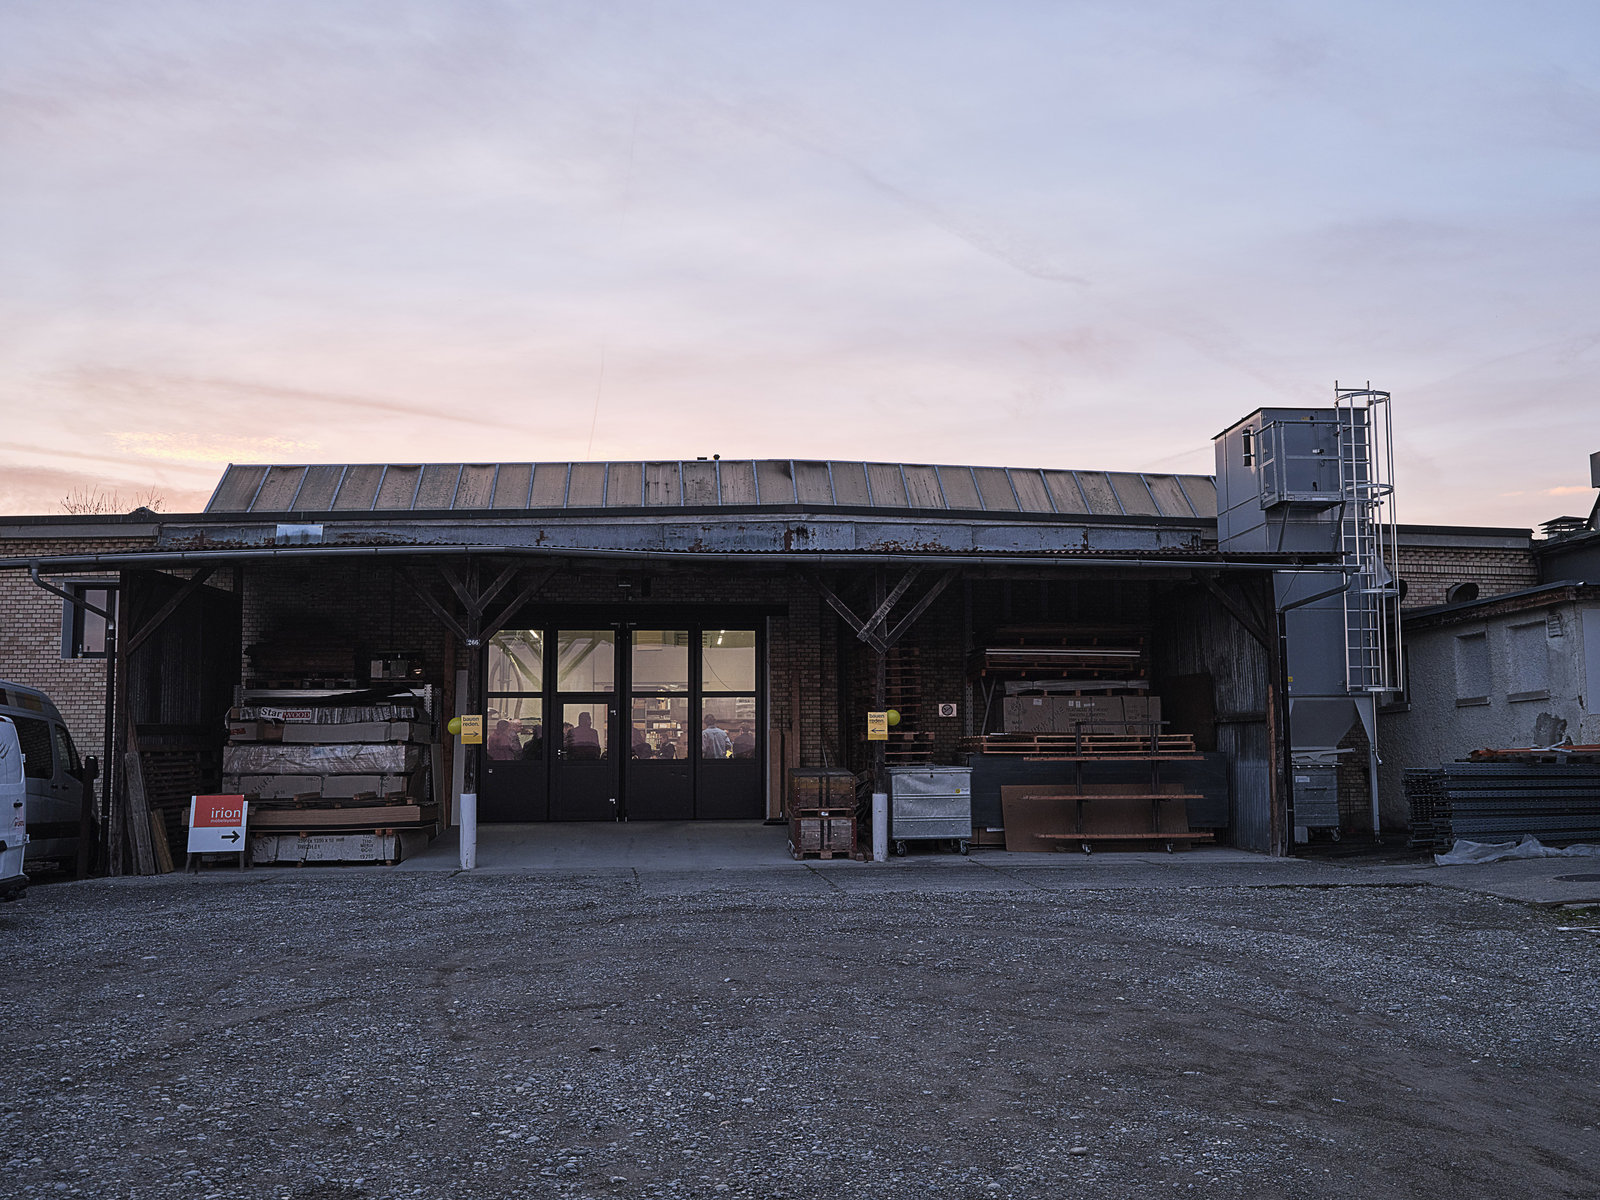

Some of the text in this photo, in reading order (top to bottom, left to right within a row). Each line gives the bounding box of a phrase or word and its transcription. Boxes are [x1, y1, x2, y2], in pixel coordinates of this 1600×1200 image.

[261, 708, 311, 719] Star WOOD
[211, 807, 241, 819] irion
